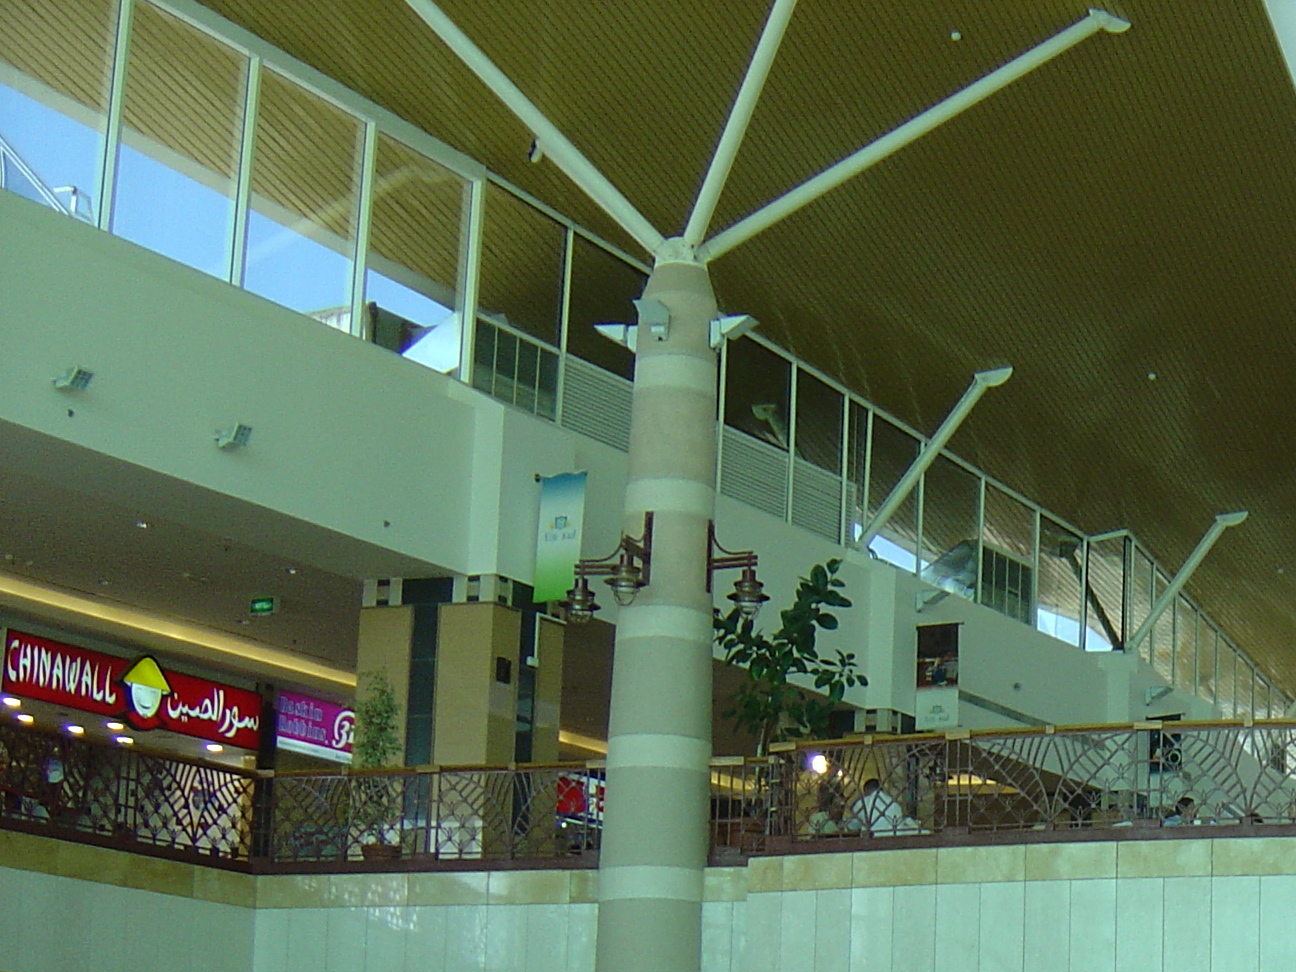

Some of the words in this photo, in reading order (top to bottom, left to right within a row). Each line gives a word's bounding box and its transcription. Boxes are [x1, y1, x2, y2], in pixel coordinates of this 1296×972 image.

[7, 639, 116, 704] CHINAWALL
[167, 687, 224, 722] الصين
[218, 705, 259, 738] سور
